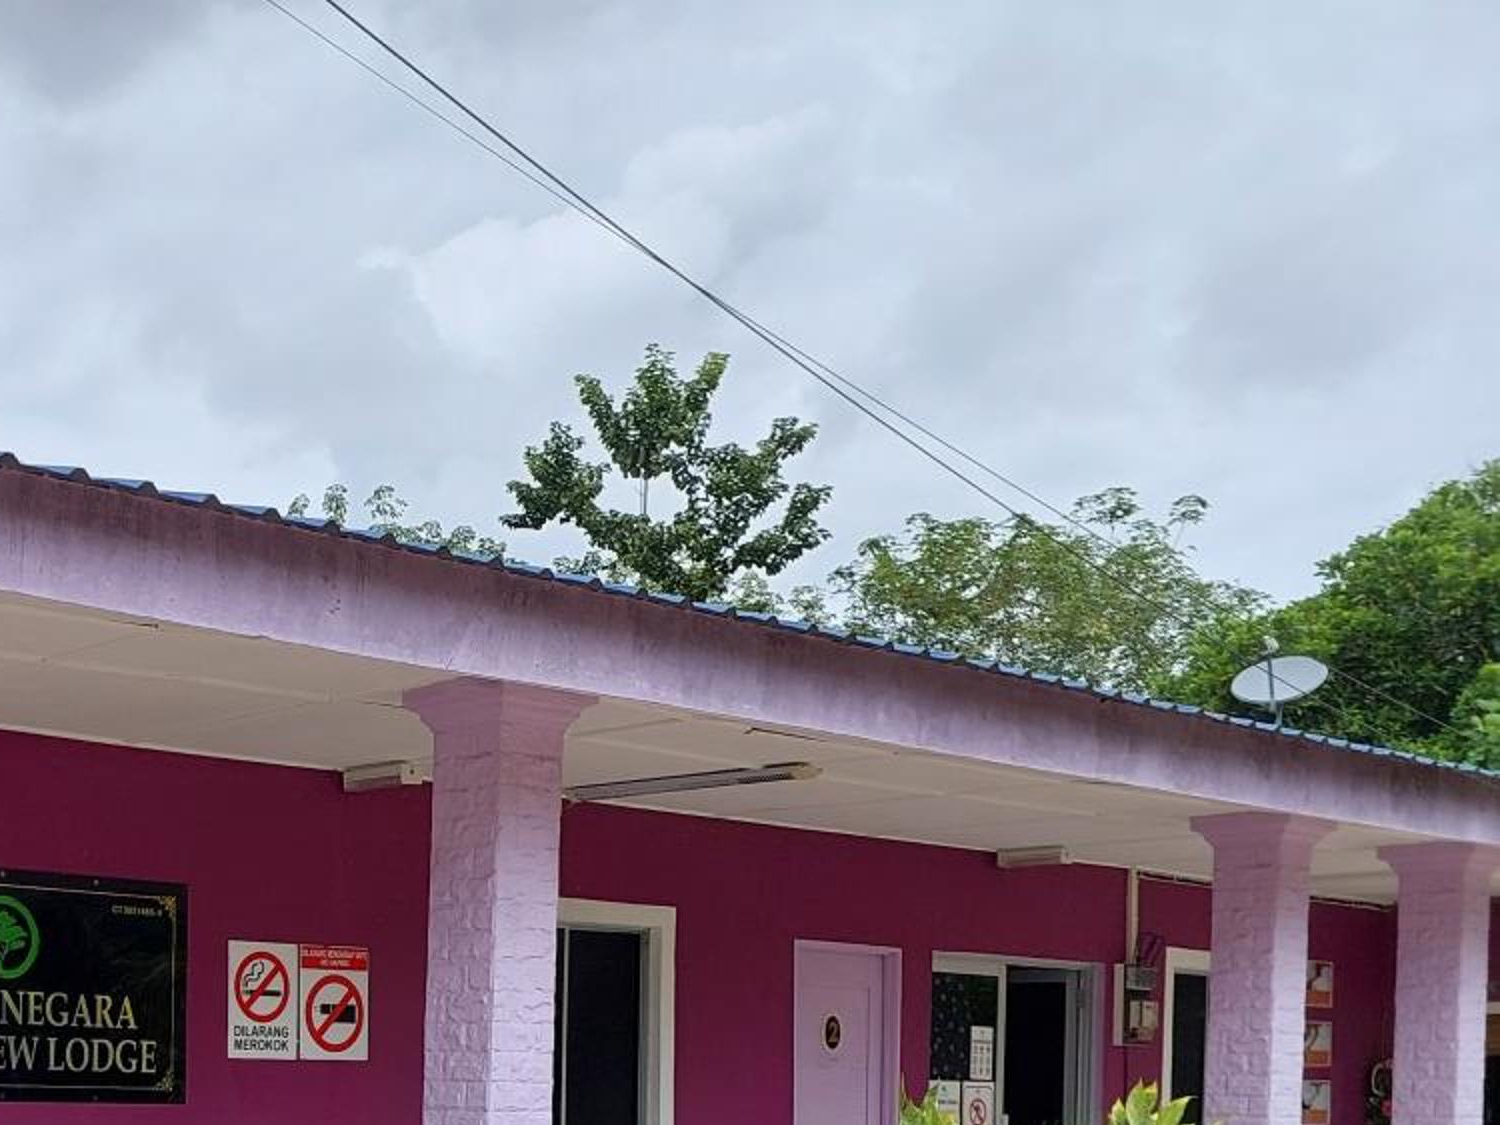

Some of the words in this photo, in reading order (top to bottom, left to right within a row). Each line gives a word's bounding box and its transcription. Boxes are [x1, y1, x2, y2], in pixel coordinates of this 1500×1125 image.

[0, 989, 139, 1030] NEGARA
[233, 1025, 289, 1039] DILARANG
[827, 1021, 838, 1043] 2
[47, 1037, 158, 1074] LODGE
[233, 1039, 290, 1052] MEROKOK
